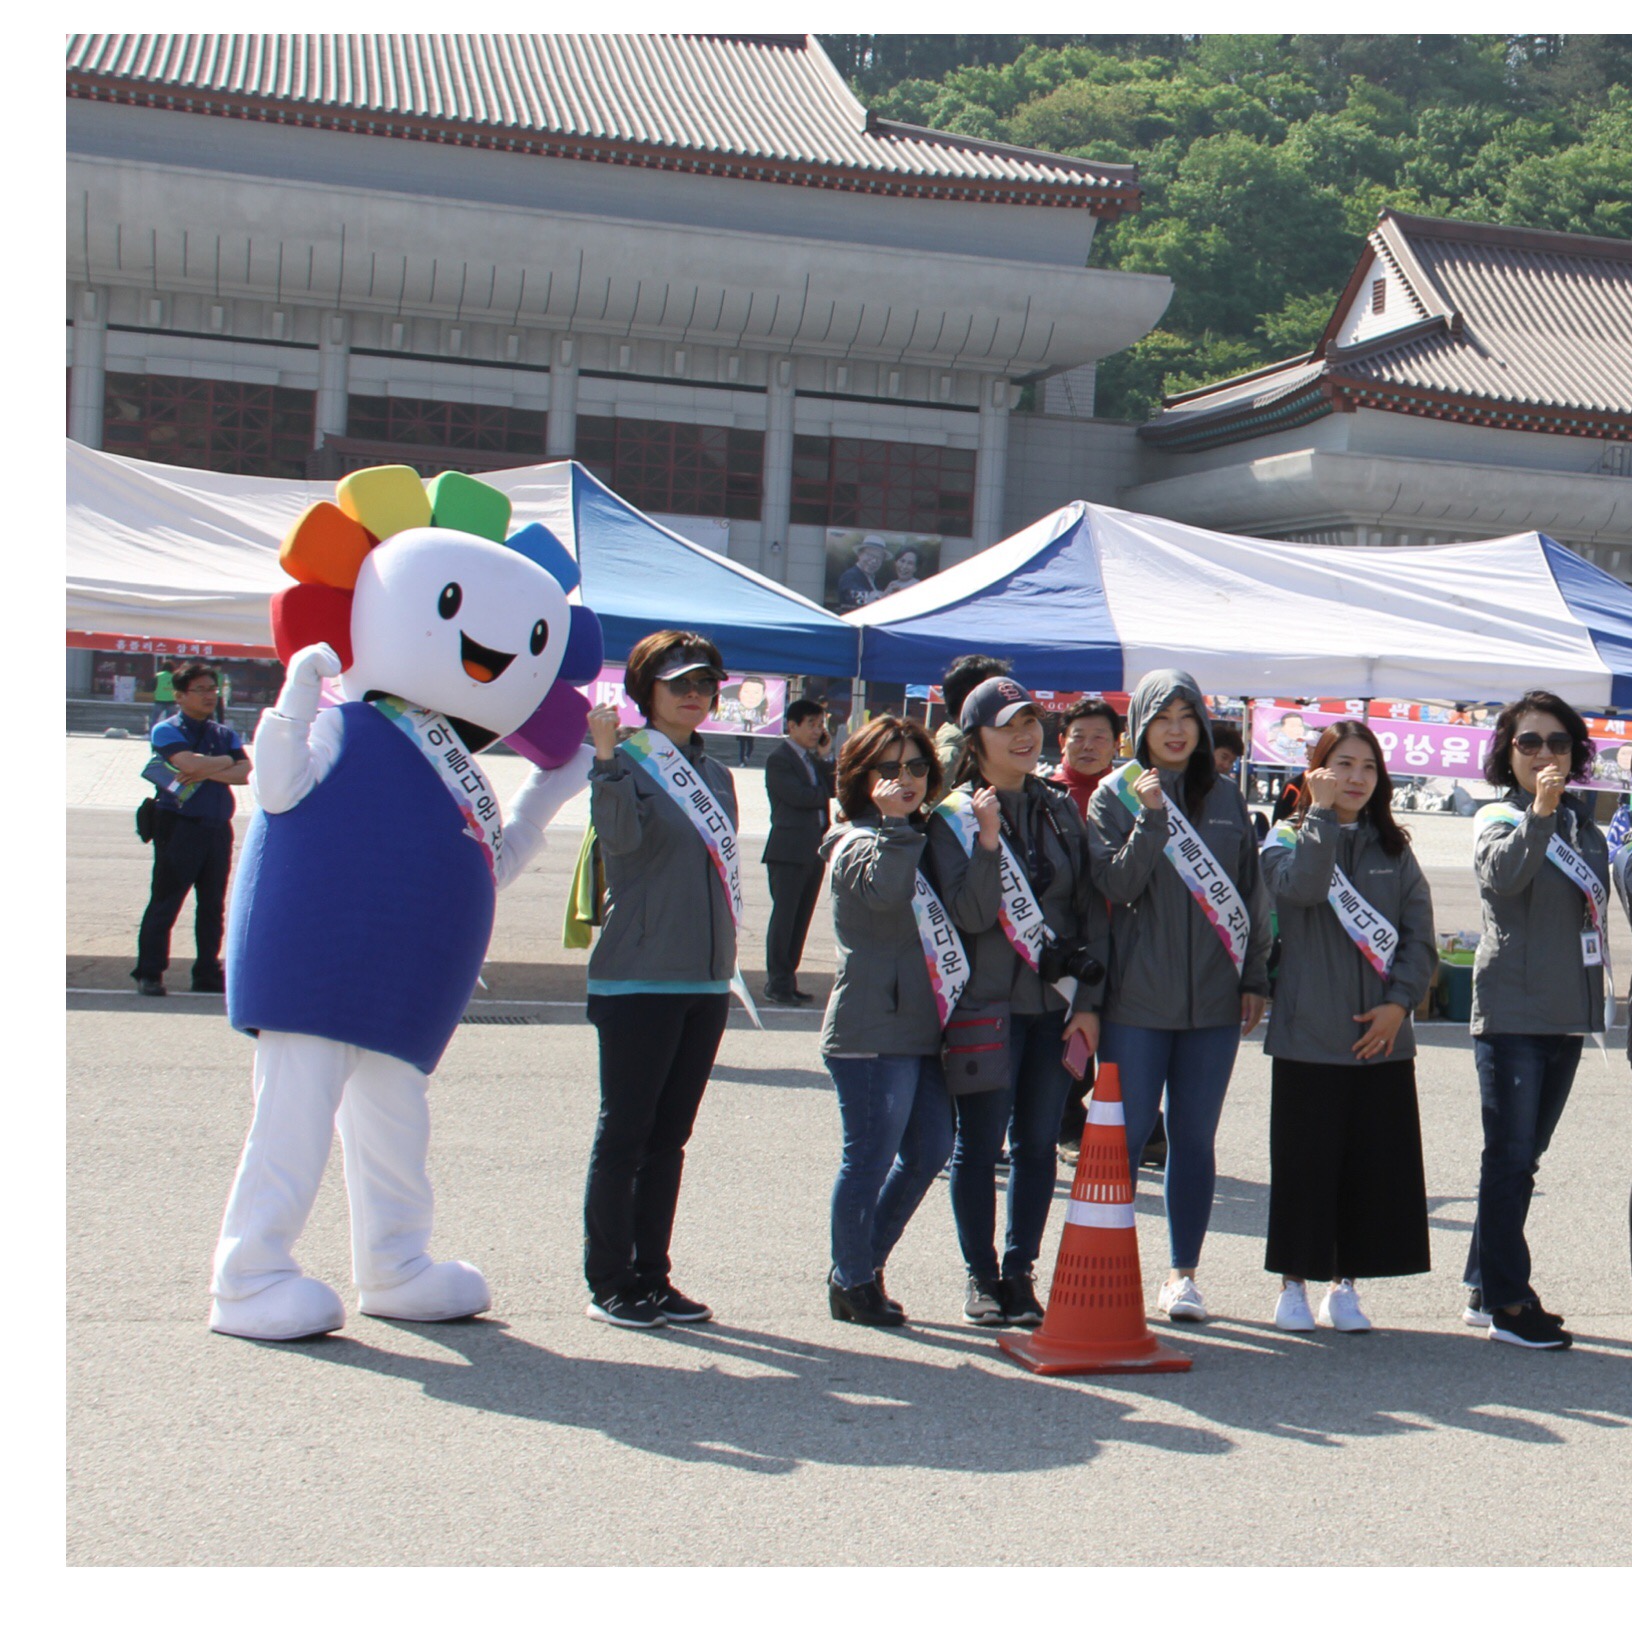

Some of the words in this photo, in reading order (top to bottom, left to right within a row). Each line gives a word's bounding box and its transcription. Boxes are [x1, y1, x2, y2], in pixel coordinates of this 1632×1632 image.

[116, 639, 167, 652] 홈플러스
[427, 719, 496, 822] 아름다운
[672, 766, 737, 861] 아름다운
